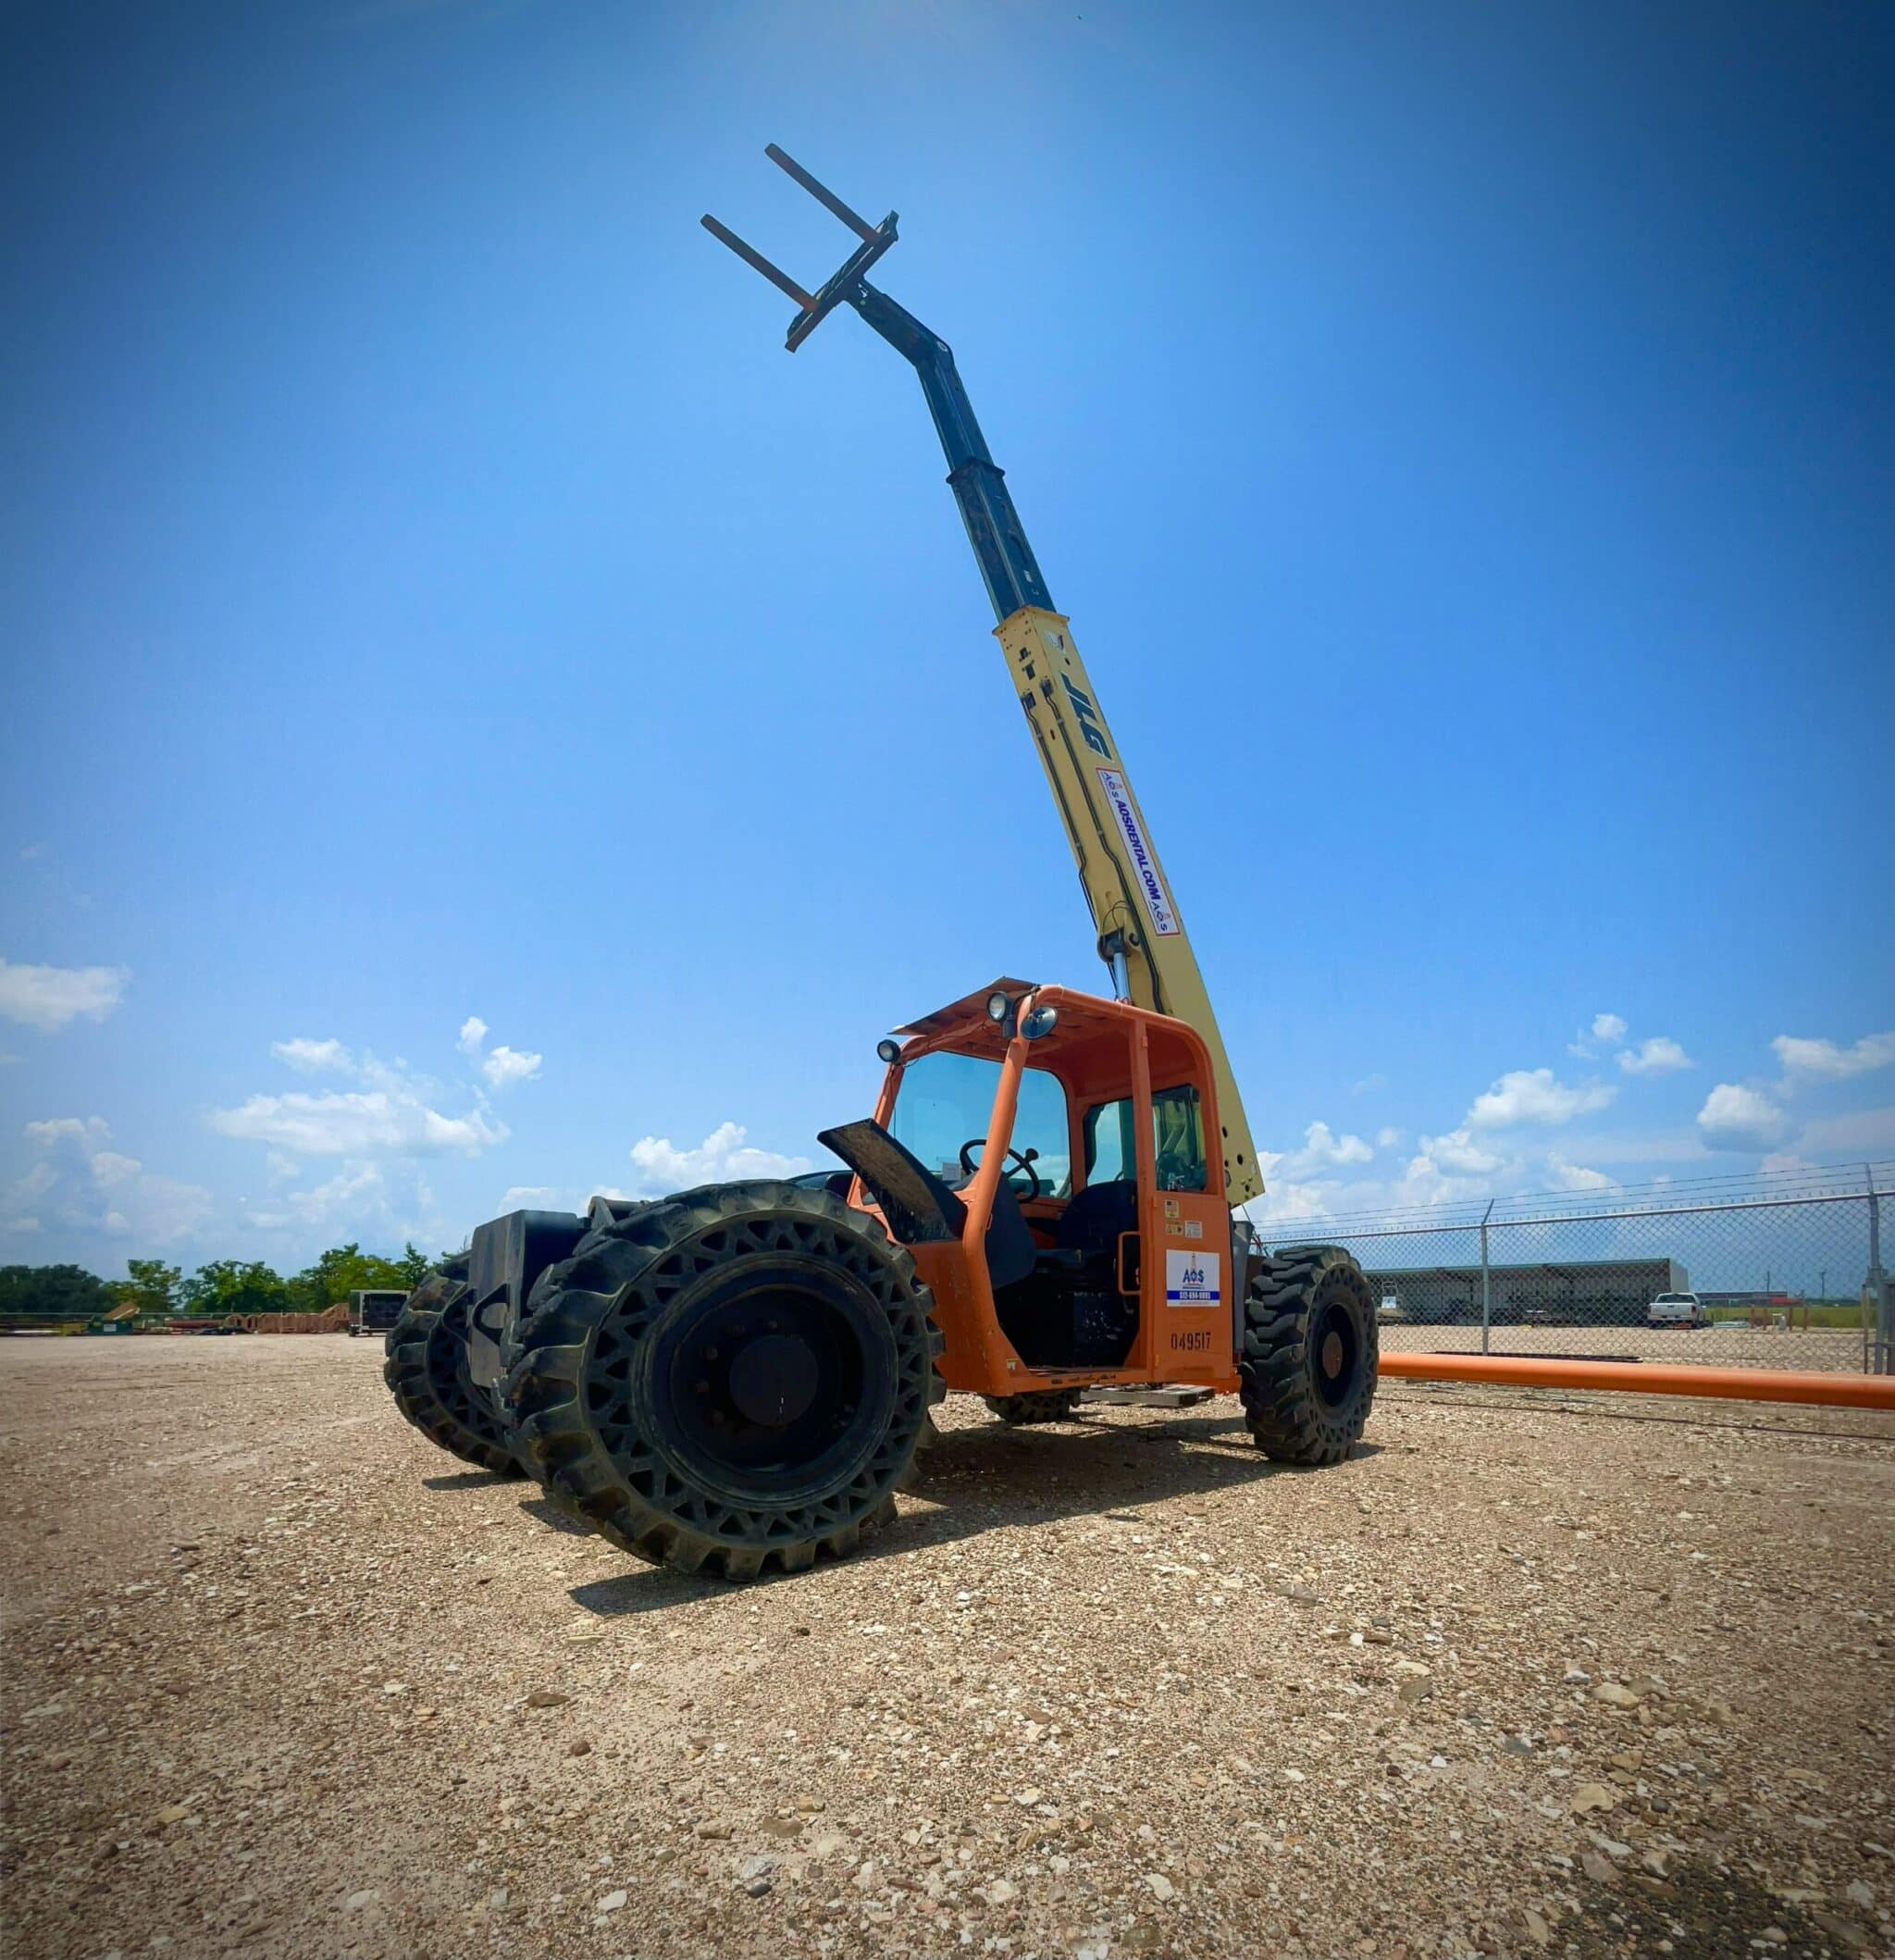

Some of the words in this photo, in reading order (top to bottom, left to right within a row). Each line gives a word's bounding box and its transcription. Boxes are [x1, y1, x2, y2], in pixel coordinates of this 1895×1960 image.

[1059, 670, 1113, 762] JLG
[1182, 1268, 1205, 1284] AOS
[1170, 1332, 1212, 1350] 049517
